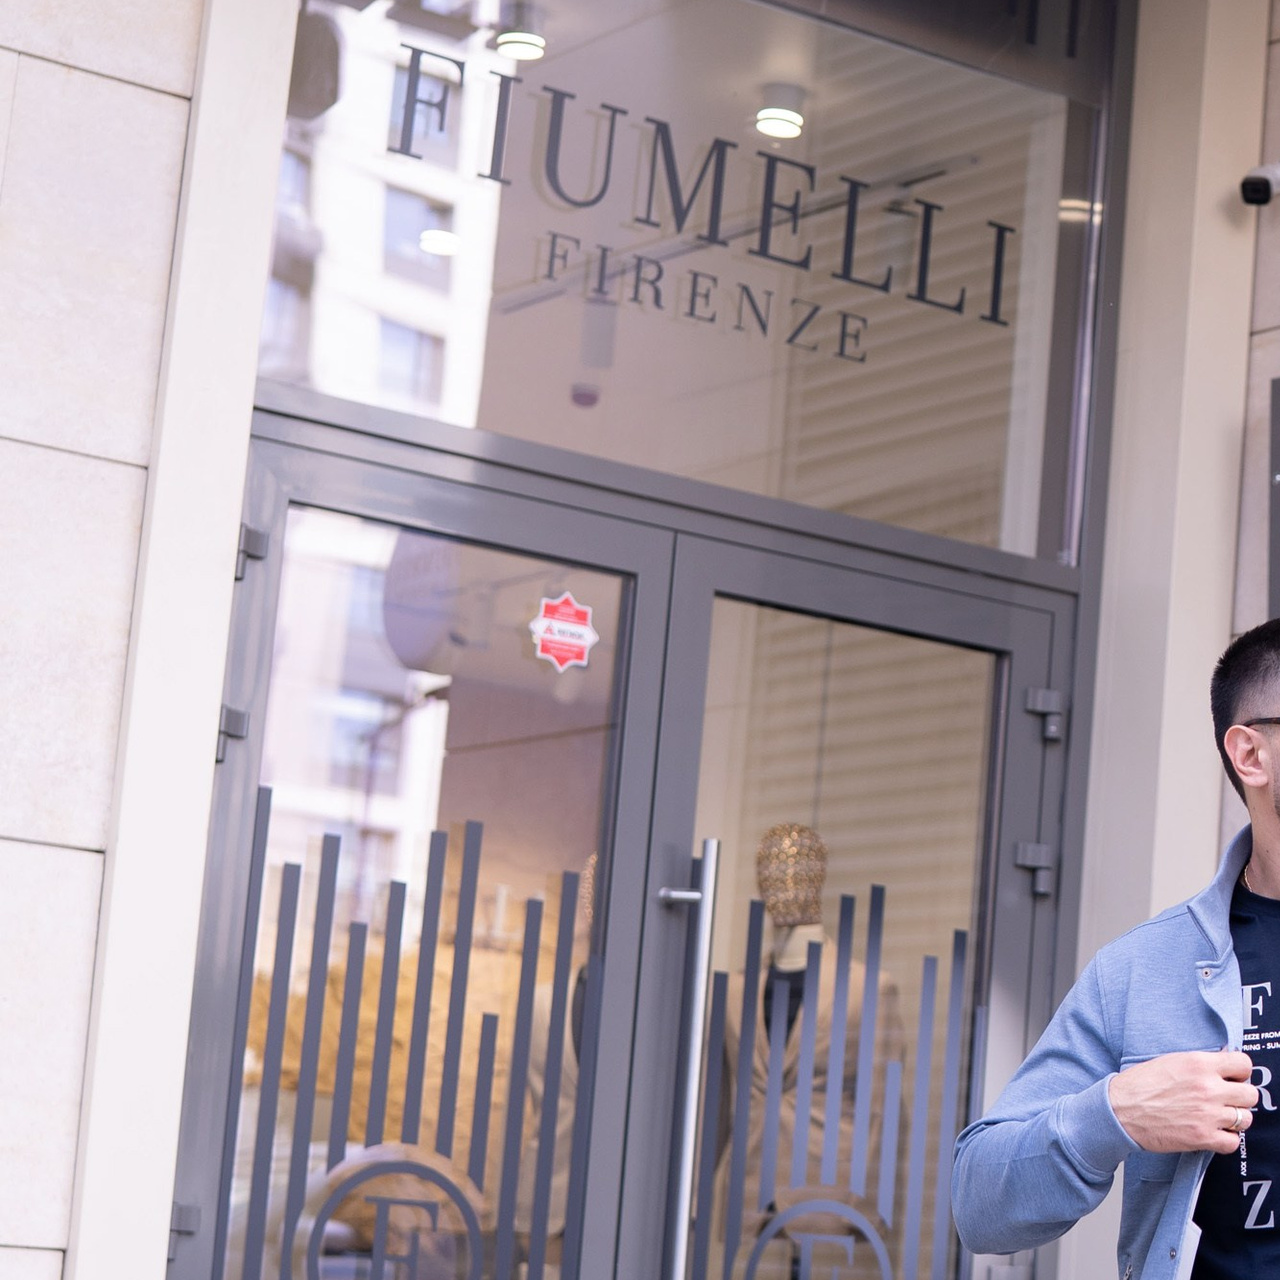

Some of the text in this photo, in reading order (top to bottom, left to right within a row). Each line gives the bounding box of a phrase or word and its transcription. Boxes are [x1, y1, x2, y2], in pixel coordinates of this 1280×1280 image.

[386, 42, 1016, 327] FIUMELLI
[541, 230, 869, 363] FIRENZE
[1241, 981, 1272, 1030] F
[1242, 1043, 1261, 1051] RING
[1243, 1033, 1260, 1041] EEZE
[1261, 1031, 1280, 1039] FROM
[1243, 1179, 1275, 1230] Z
